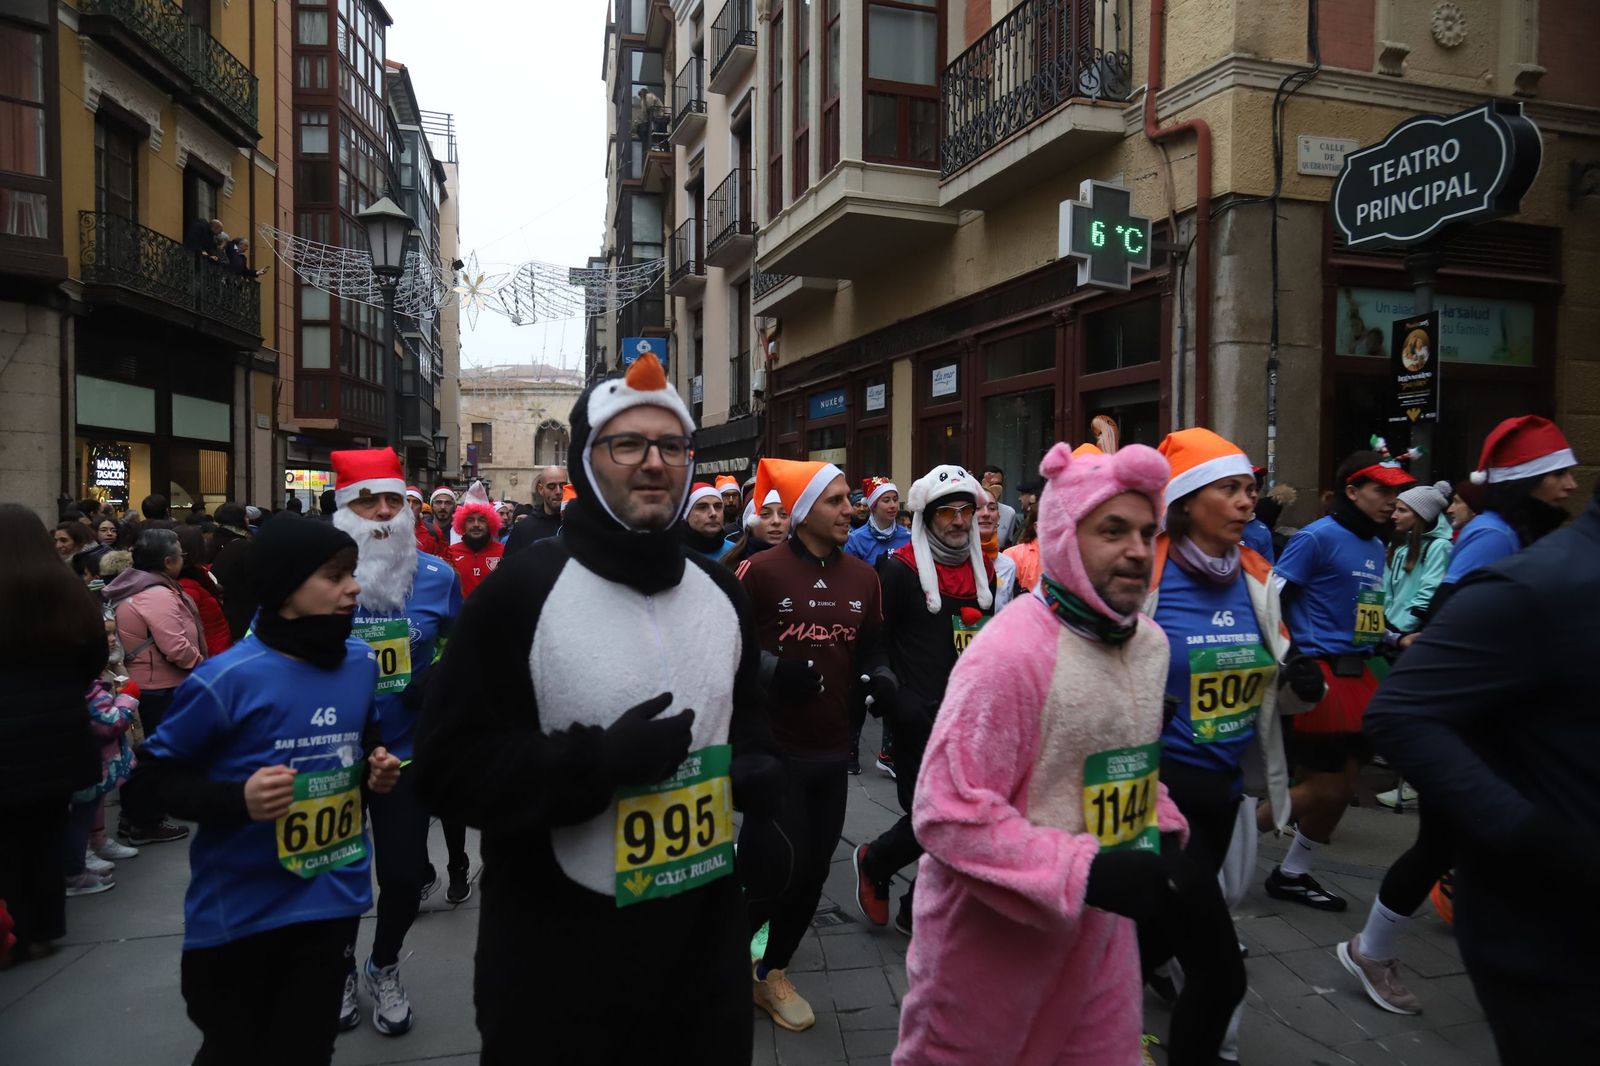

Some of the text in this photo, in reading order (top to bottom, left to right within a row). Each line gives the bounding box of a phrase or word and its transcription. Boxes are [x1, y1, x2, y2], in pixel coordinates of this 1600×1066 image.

[1319, 143, 1345, 152] CALLE
[1324, 153, 1336, 161] DE
[1369, 138, 1460, 187] TEATRO
[1356, 171, 1478, 226] PRINCIPAL
[1092, 221, 1105, 247] 6
[1375, 301, 1391, 313] Un
[1454, 304, 1490, 320] salud
[1454, 322, 1489, 337] familia
[820, 397, 838, 408] NUXE
[96, 457, 125, 470] MÁXIMA
[96, 468, 125, 479] TASACIÓN
[473, 567, 481, 576] 12
[1211, 610, 1236, 627] 46
[1360, 609, 1379, 632] 719
[1186, 635, 1204, 644] SAN
[1205, 633, 1245, 643] SILVESTRE
[377, 678, 408, 690] RURAL
[1197, 672, 1263, 713] 500
[310, 706, 338, 727] 46
[274, 738, 295, 750] SAN
[296, 732, 342, 748] SILVESTRE
[1091, 778, 1150, 838] 1144
[283, 799, 354, 854] 606
[623, 794, 715, 866] 995
[304, 843, 362, 869] CAJA RURAL
[654, 853, 727, 887] CAJA RURAL
